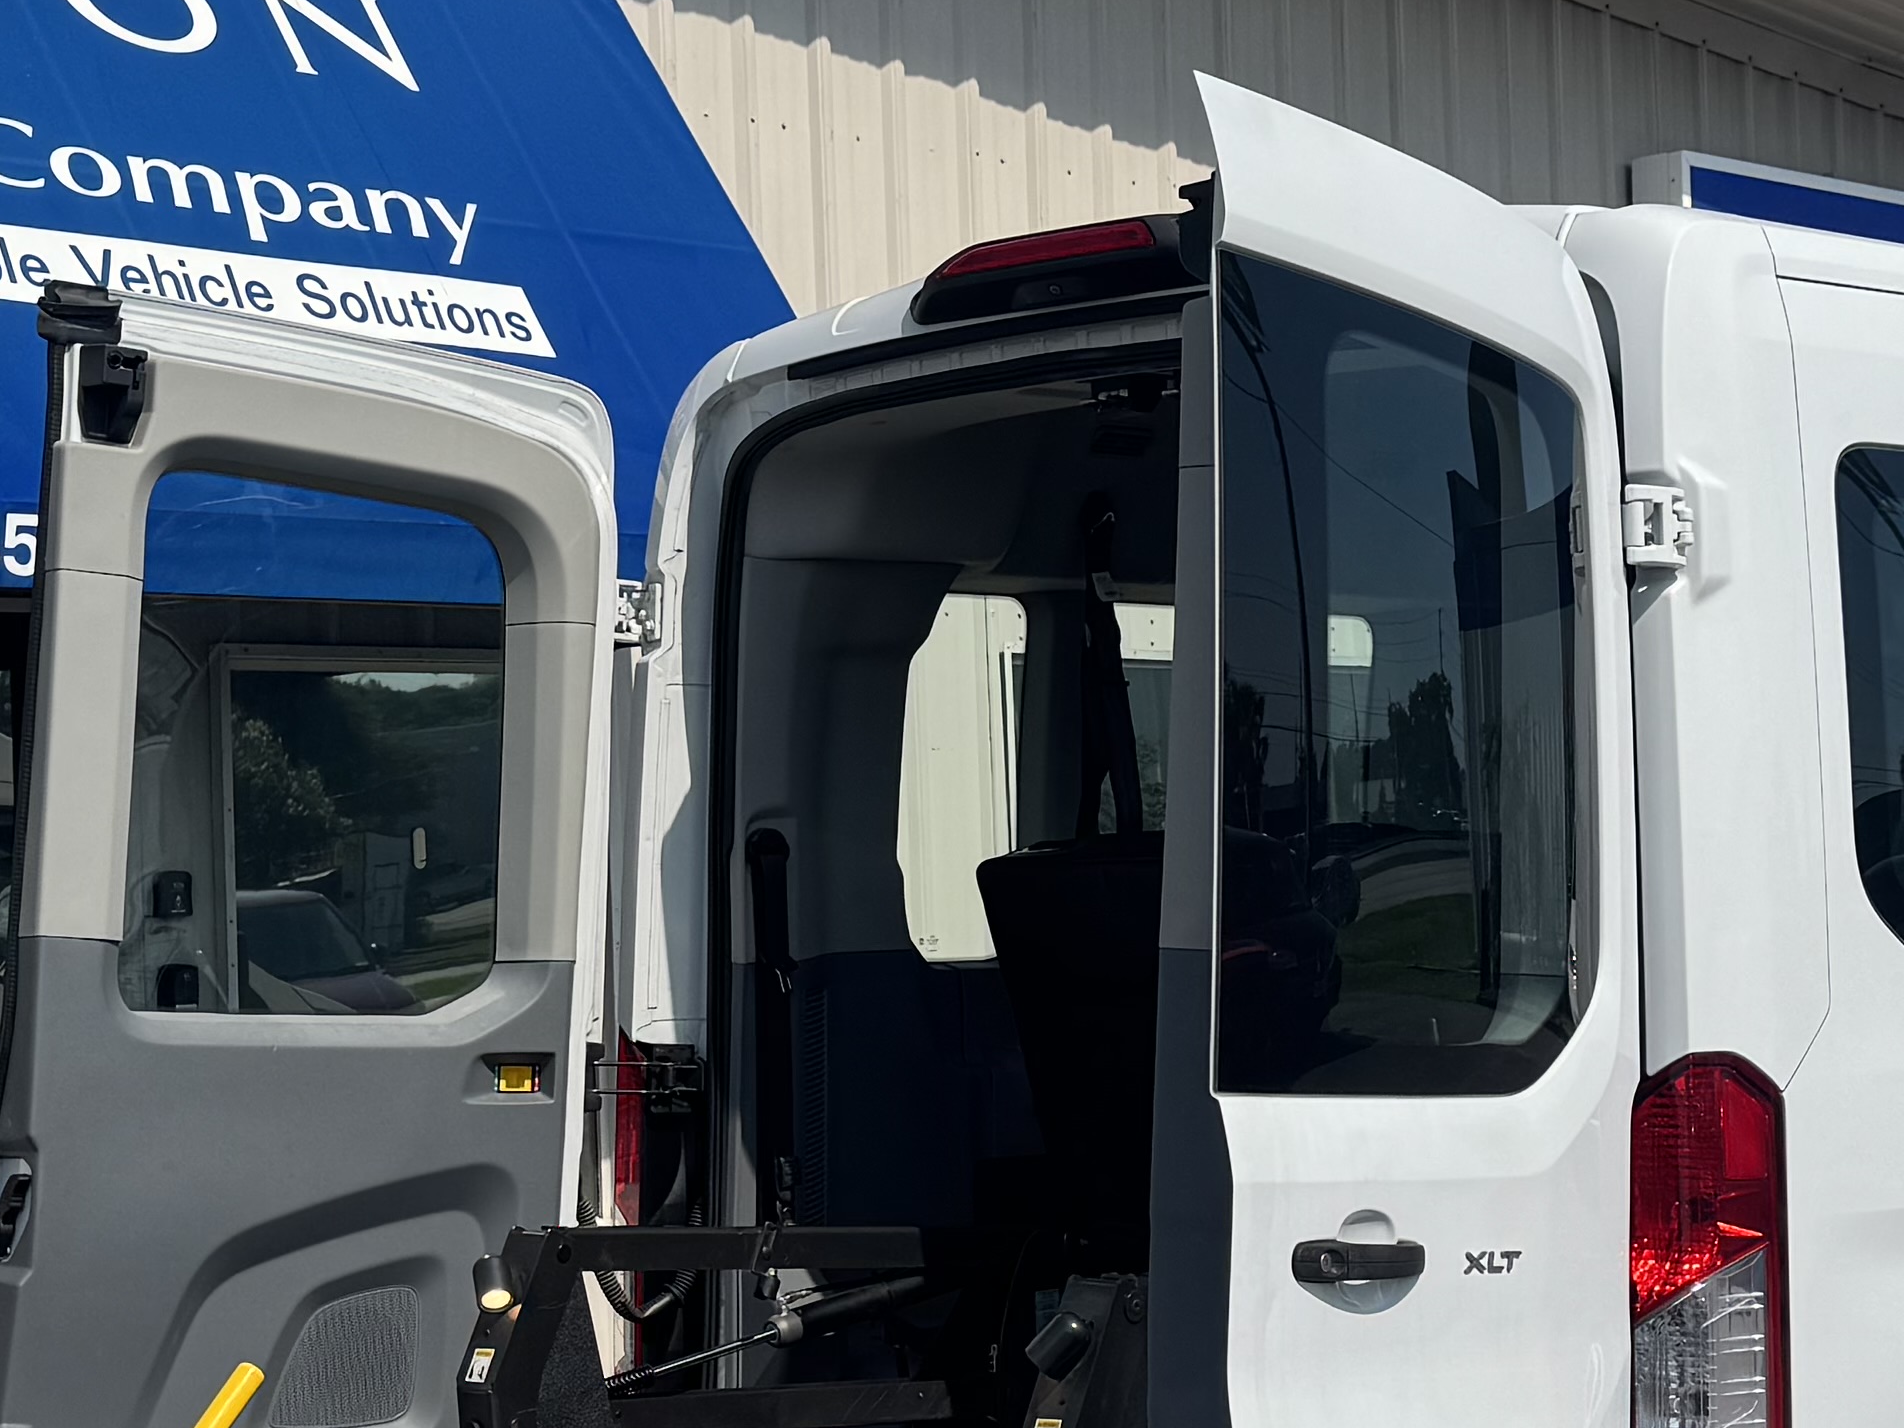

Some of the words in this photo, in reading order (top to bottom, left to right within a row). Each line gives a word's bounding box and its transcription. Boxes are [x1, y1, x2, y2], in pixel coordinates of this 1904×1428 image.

[68, 245, 276, 313] Vehicle
[301, 275, 533, 344] Solutions
[1463, 1250, 1522, 1275] XLT
